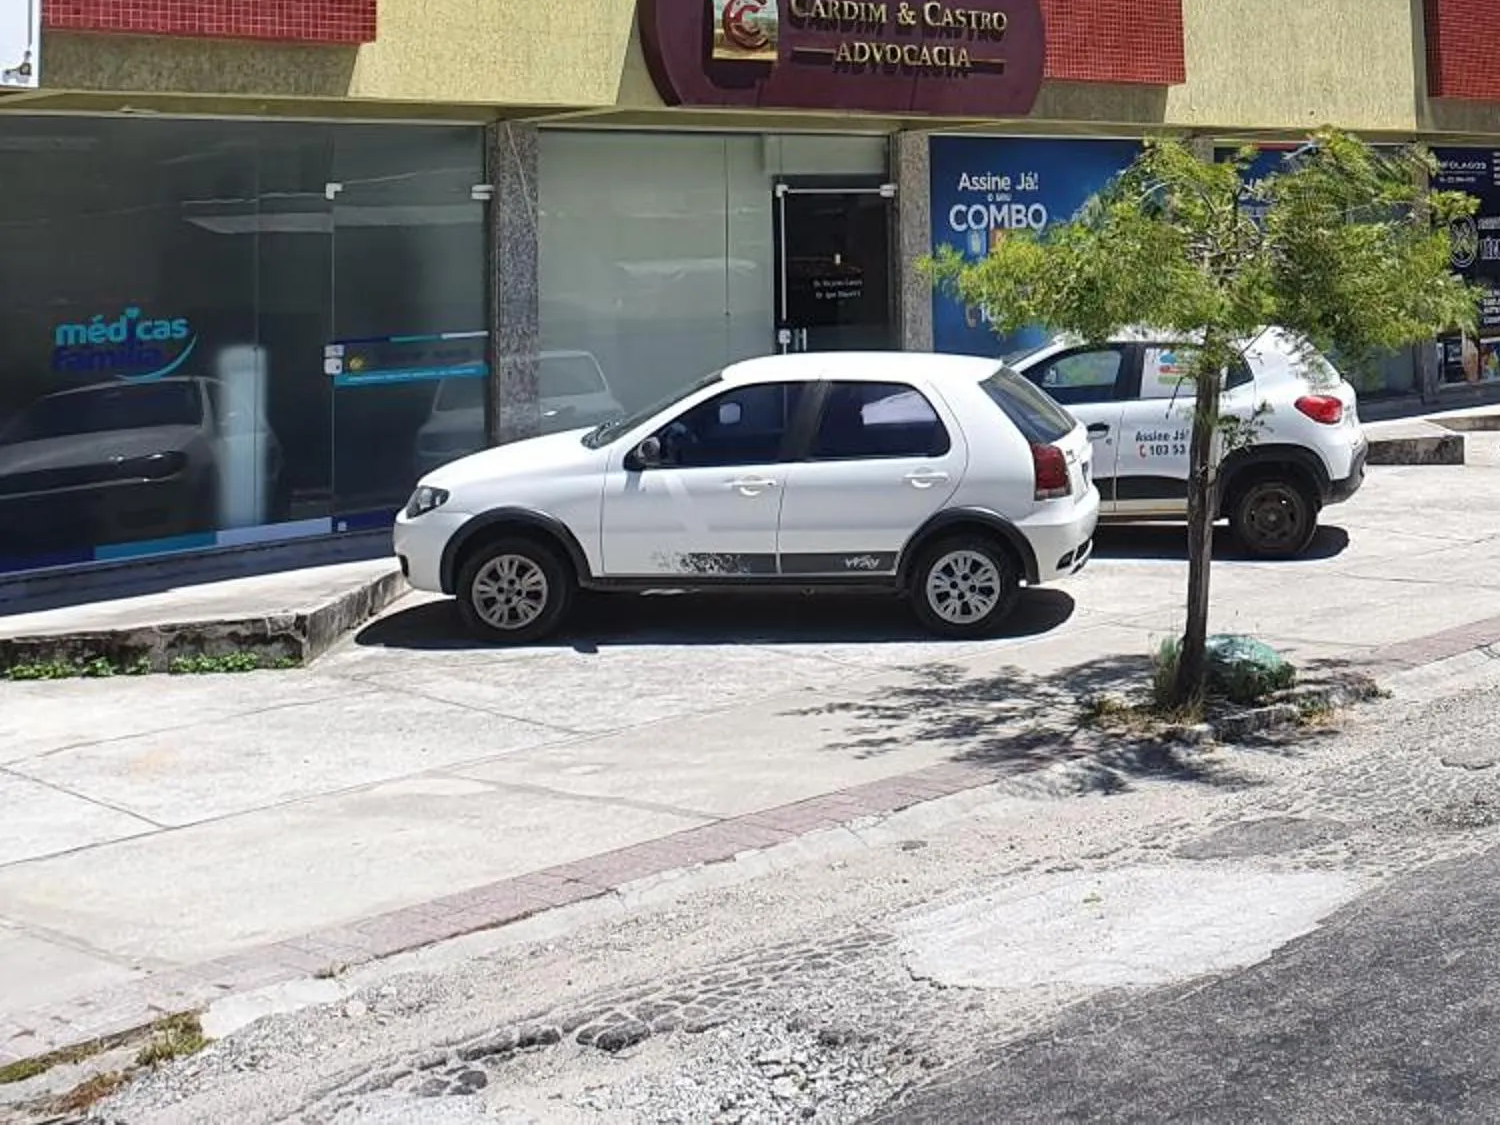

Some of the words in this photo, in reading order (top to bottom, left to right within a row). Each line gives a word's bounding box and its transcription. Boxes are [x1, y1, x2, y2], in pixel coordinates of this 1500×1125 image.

[897, 3, 916, 24] &
[835, 42, 972, 68] ADVOCACIA
[958, 171, 1011, 191] Assine
[1016, 171, 1039, 190] Já!
[949, 203, 1047, 232] COMBO
[1135, 430, 1169, 442] Assine
[1149, 444, 1169, 456] 103
